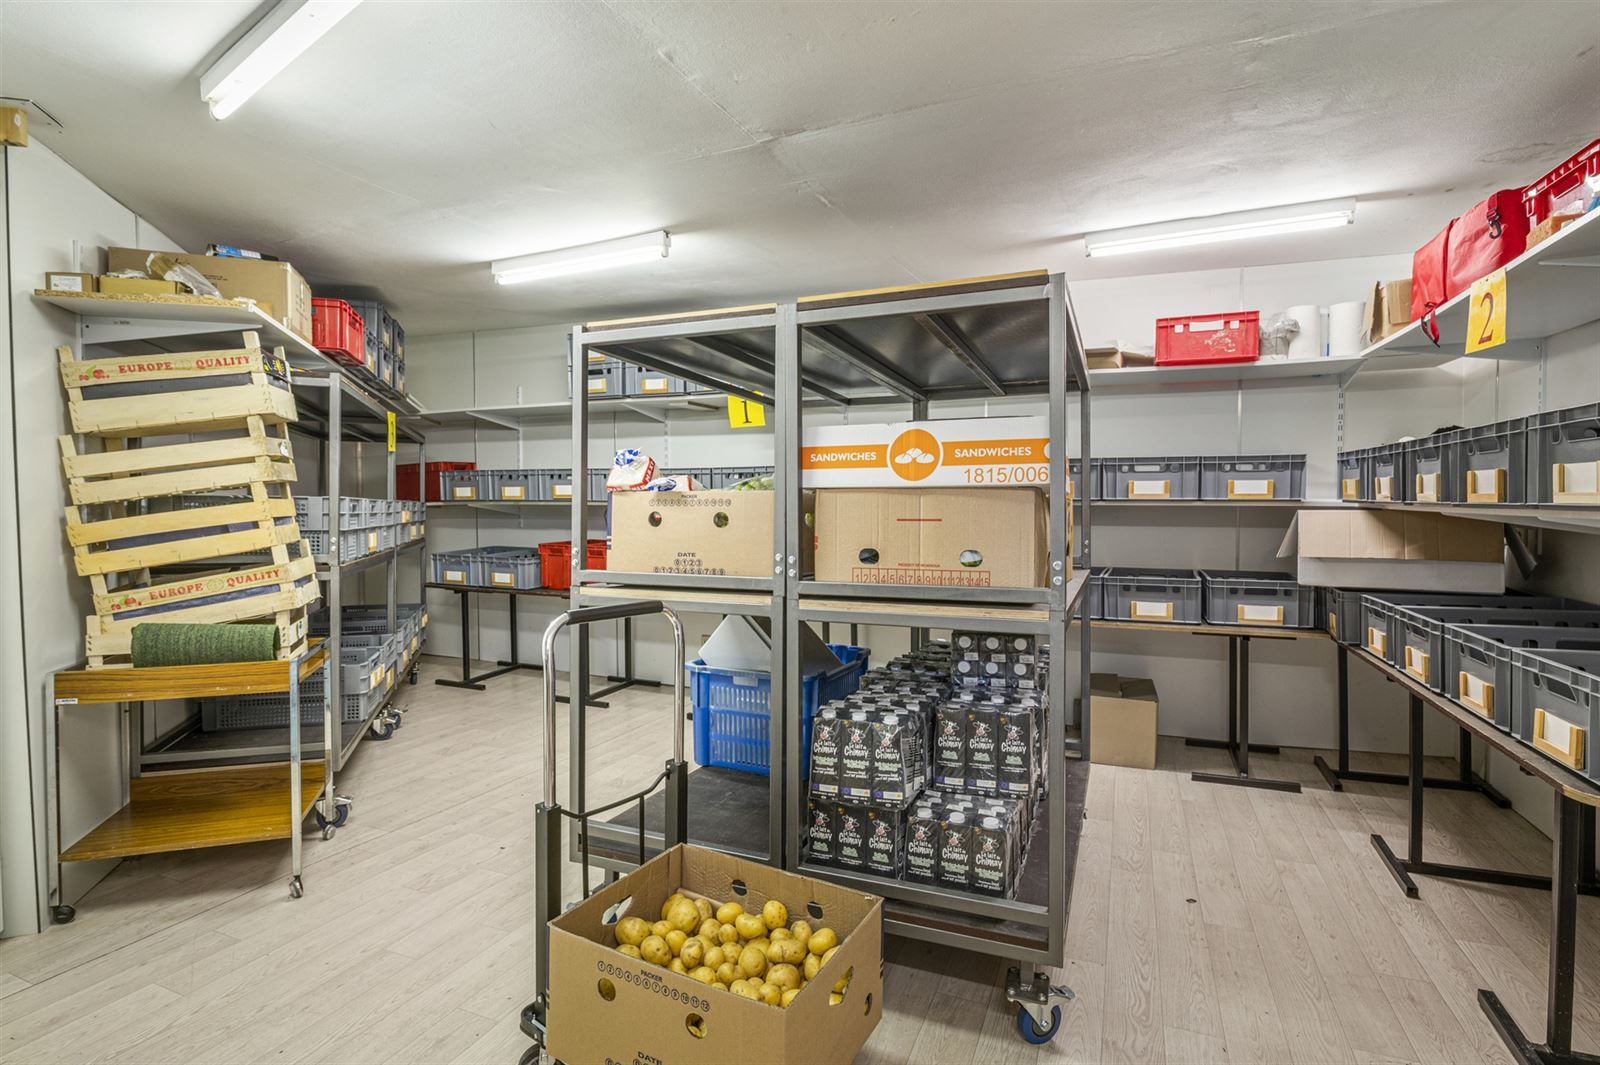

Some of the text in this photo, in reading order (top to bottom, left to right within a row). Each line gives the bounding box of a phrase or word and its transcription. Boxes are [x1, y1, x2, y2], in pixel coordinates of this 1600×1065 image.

[1478, 291, 1494, 345] 2
[118, 361, 172, 374] EUROPE
[195, 355, 250, 369] QUALITY
[740, 400, 752, 424] 1
[810, 451, 877, 463] SANDWICHES
[954, 446, 1032, 458] SANDWICHES
[964, 466, 1048, 484] 1815/006
[150, 568, 280, 600] EUROPE QUALITY
[814, 743, 837, 755] Chimay
[938, 737, 962, 750] Chimay
[970, 738, 994, 751] Chimay
[1002, 743, 1026, 754] Chimay
[844, 746, 868, 758] Chimay
[875, 749, 900, 761] Chimay
[810, 827, 832, 841] Chimay
[839, 833, 862, 846] Chimay
[869, 838, 893, 852] Chimay
[909, 842, 933, 856] Chimay
[942, 848, 968, 862] Chimay
[976, 855, 1002, 869] Chimay
[640, 969, 663, 982] PACKER
